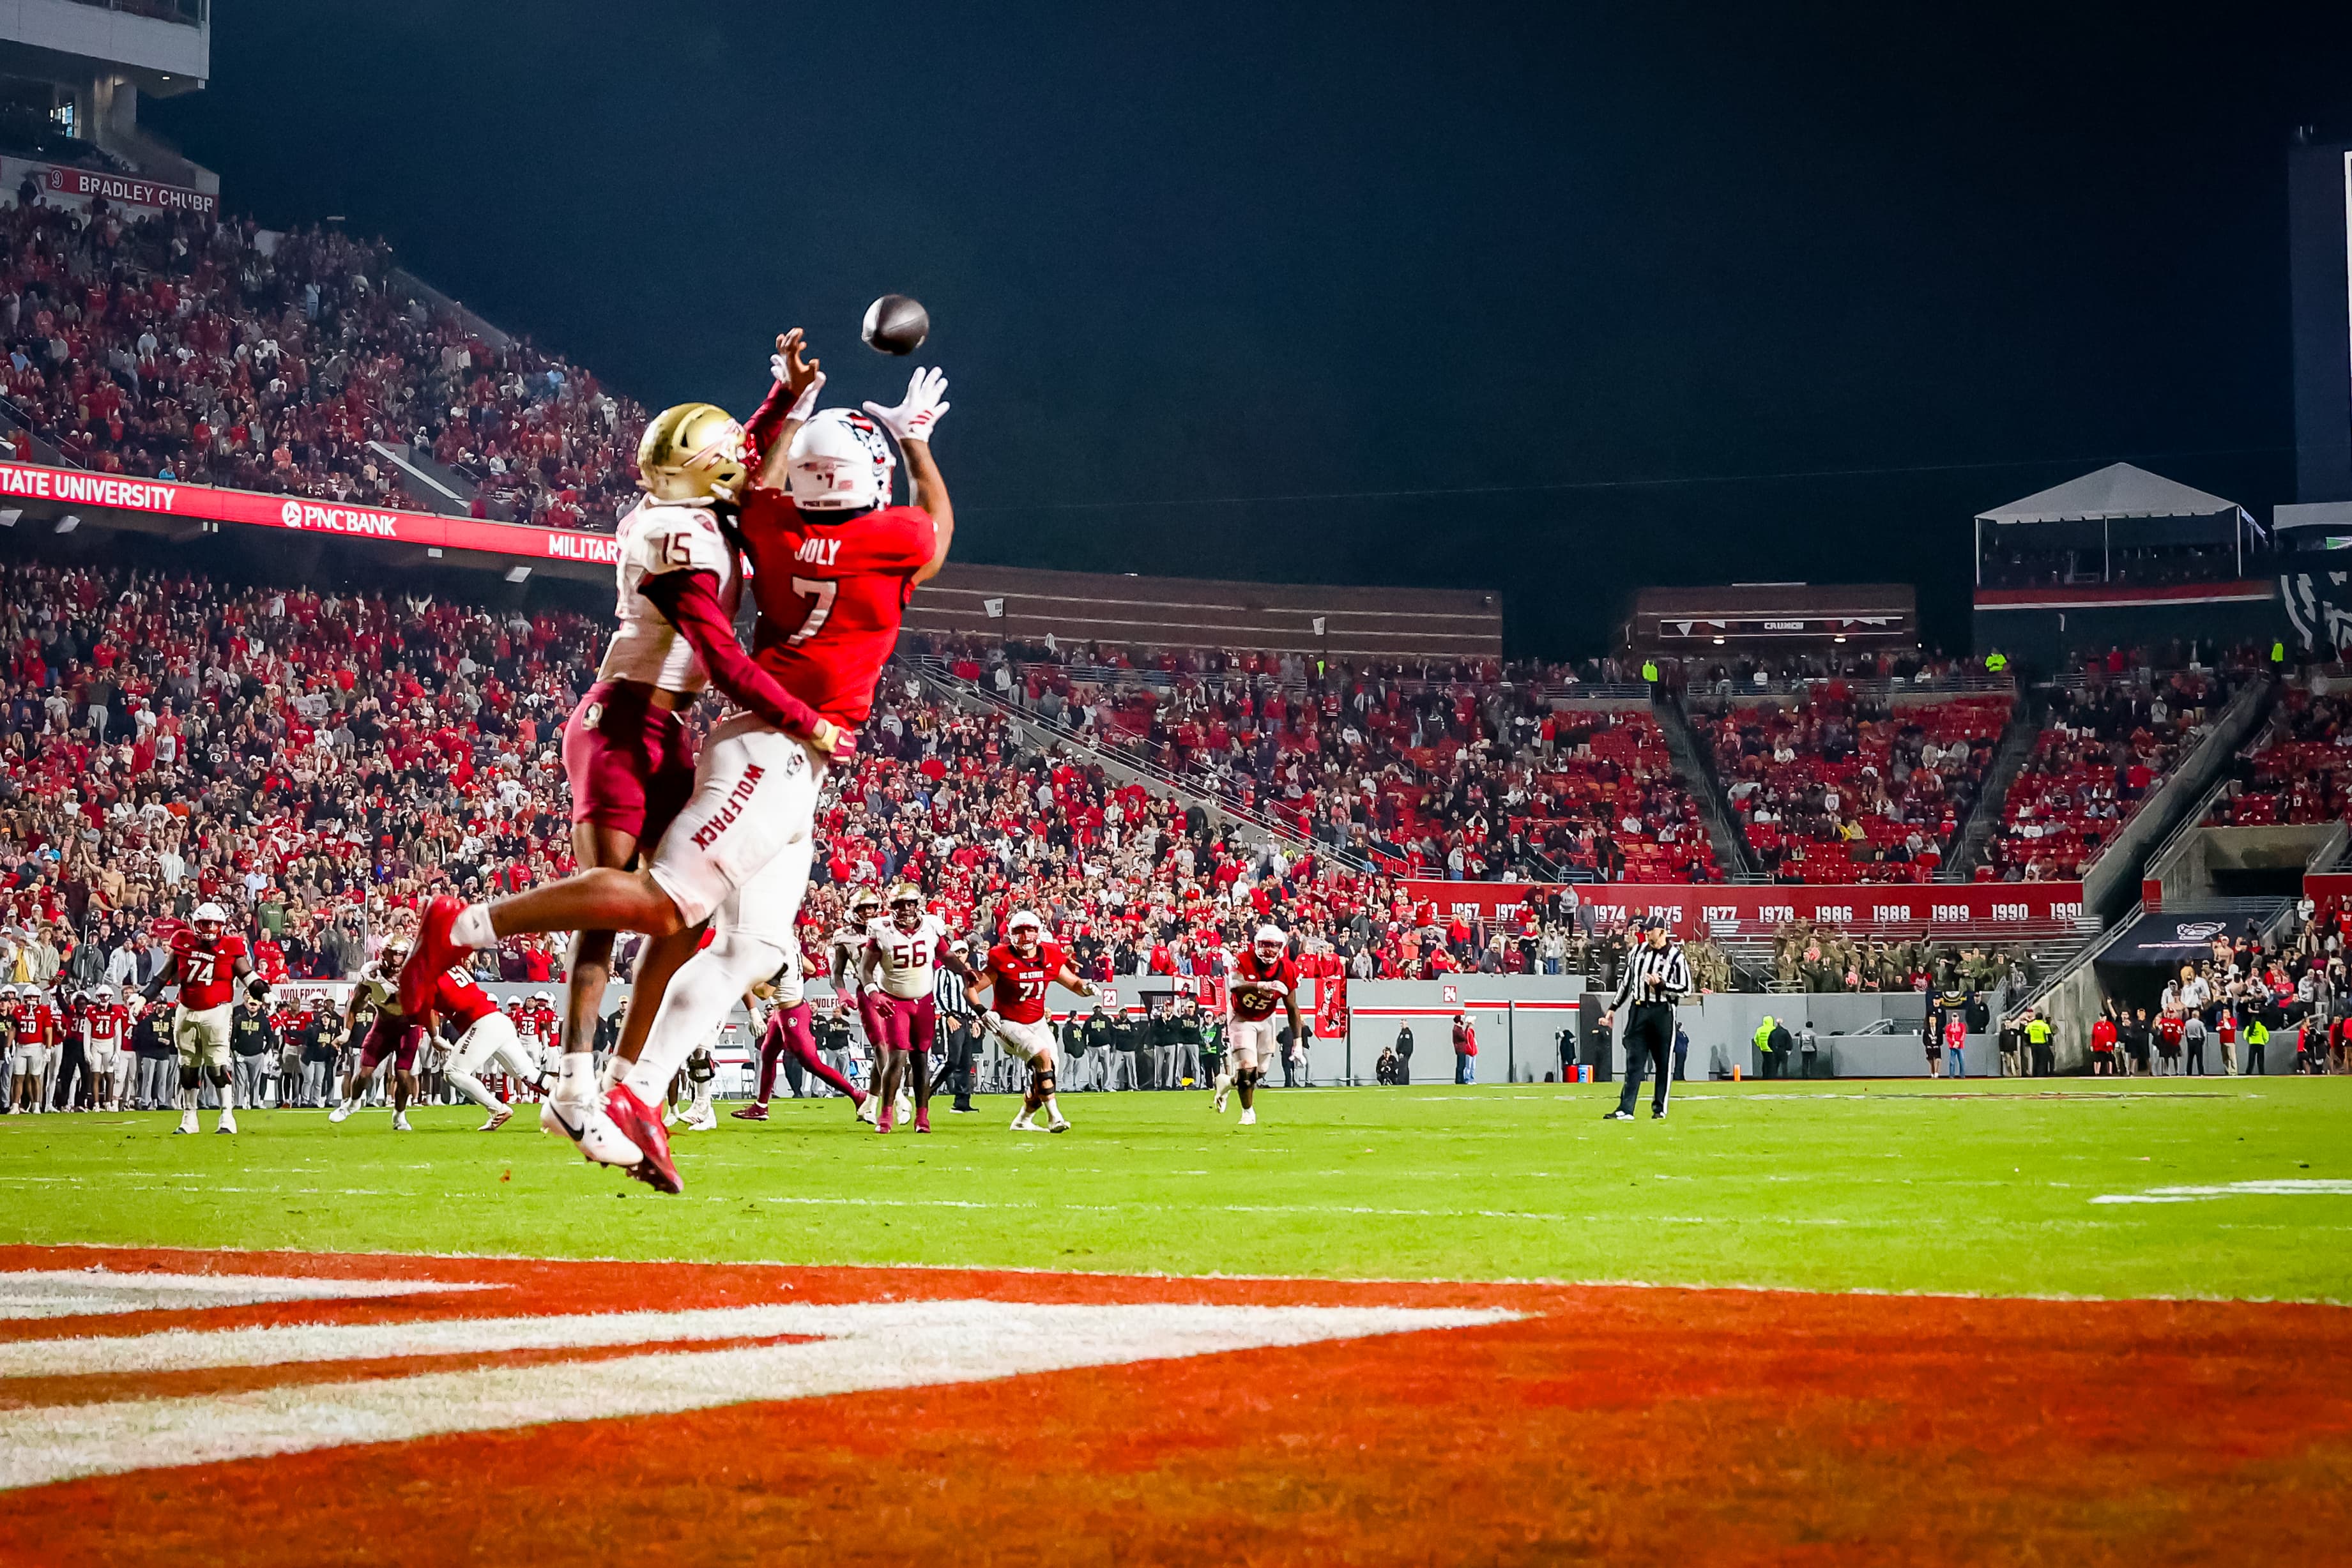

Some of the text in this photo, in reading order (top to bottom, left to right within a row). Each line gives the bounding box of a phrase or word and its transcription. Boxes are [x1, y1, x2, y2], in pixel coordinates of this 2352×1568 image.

[79, 176, 155, 202] BRADLEY
[0, 468, 175, 510] TATE UNIVERSITY
[825, 473, 834, 489] 7
[549, 534, 618, 562] MILITAR
[662, 532, 692, 565] 15
[795, 537, 842, 566] JOLY
[787, 576, 837, 646] 7
[690, 763, 765, 852] WOLFPACK
[1593, 905, 1626, 922] 1974
[1702, 906, 1737, 922] 1977
[1758, 906, 1794, 922] 1978
[1815, 906, 1852, 922] 1986
[1872, 905, 1910, 922] 1988
[1932, 904, 1969, 922] 1989
[1992, 904, 2029, 921] 1990
[2050, 902, 2082, 920] 1991
[893, 940, 927, 968] 56
[187, 959, 215, 986] 74
[1028, 971, 1044, 979] STATE
[1019, 980, 1044, 1001] 71
[1104, 991, 1117, 1007] 23
[1242, 993, 1271, 1010] 65
[1444, 987, 1456, 1001] 24
[96, 1020, 110, 1034] 41
[521, 1021, 535, 1034] 32
